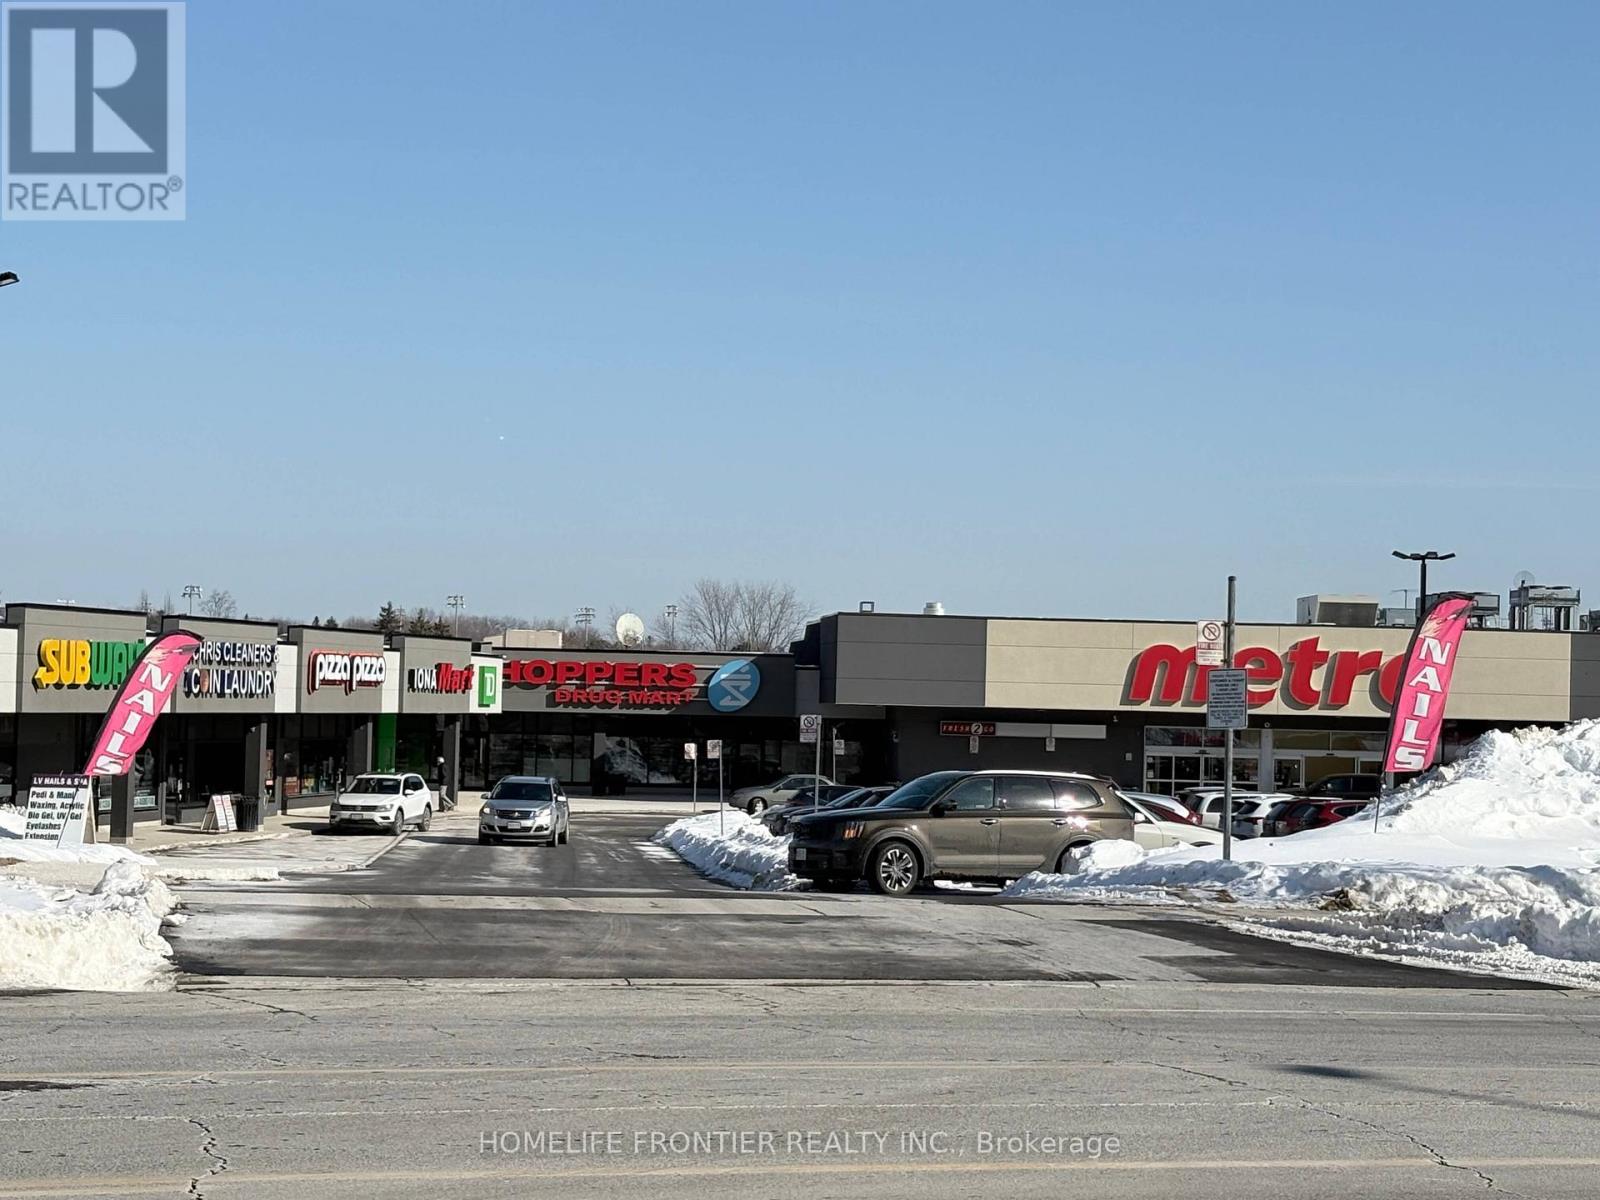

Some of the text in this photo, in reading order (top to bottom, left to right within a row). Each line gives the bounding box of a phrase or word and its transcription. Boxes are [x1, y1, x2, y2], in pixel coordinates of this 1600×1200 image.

[223, 642, 272, 663] CLEANERS
[224, 668, 278, 695] LAUNDRY
[315, 654, 386, 691] pizza pizza
[414, 662, 475, 692] IONA Mart
[502, 659, 697, 688] HOPPERS
[555, 688, 695, 707] DRUG MART
[1394, 637, 1452, 771] NAILS
[92, 663, 173, 775] NAILS
[33, 777, 43, 785] LV
[44, 777, 65, 785] NAILS
[31, 791, 47, 799] Pedi
[28, 811, 40, 820] Bio
[56, 812, 66, 820] UV
[70, 812, 82, 820] Gel
[25, 832, 59, 841] Extension
[26, 822, 61, 831] Eyelashes
